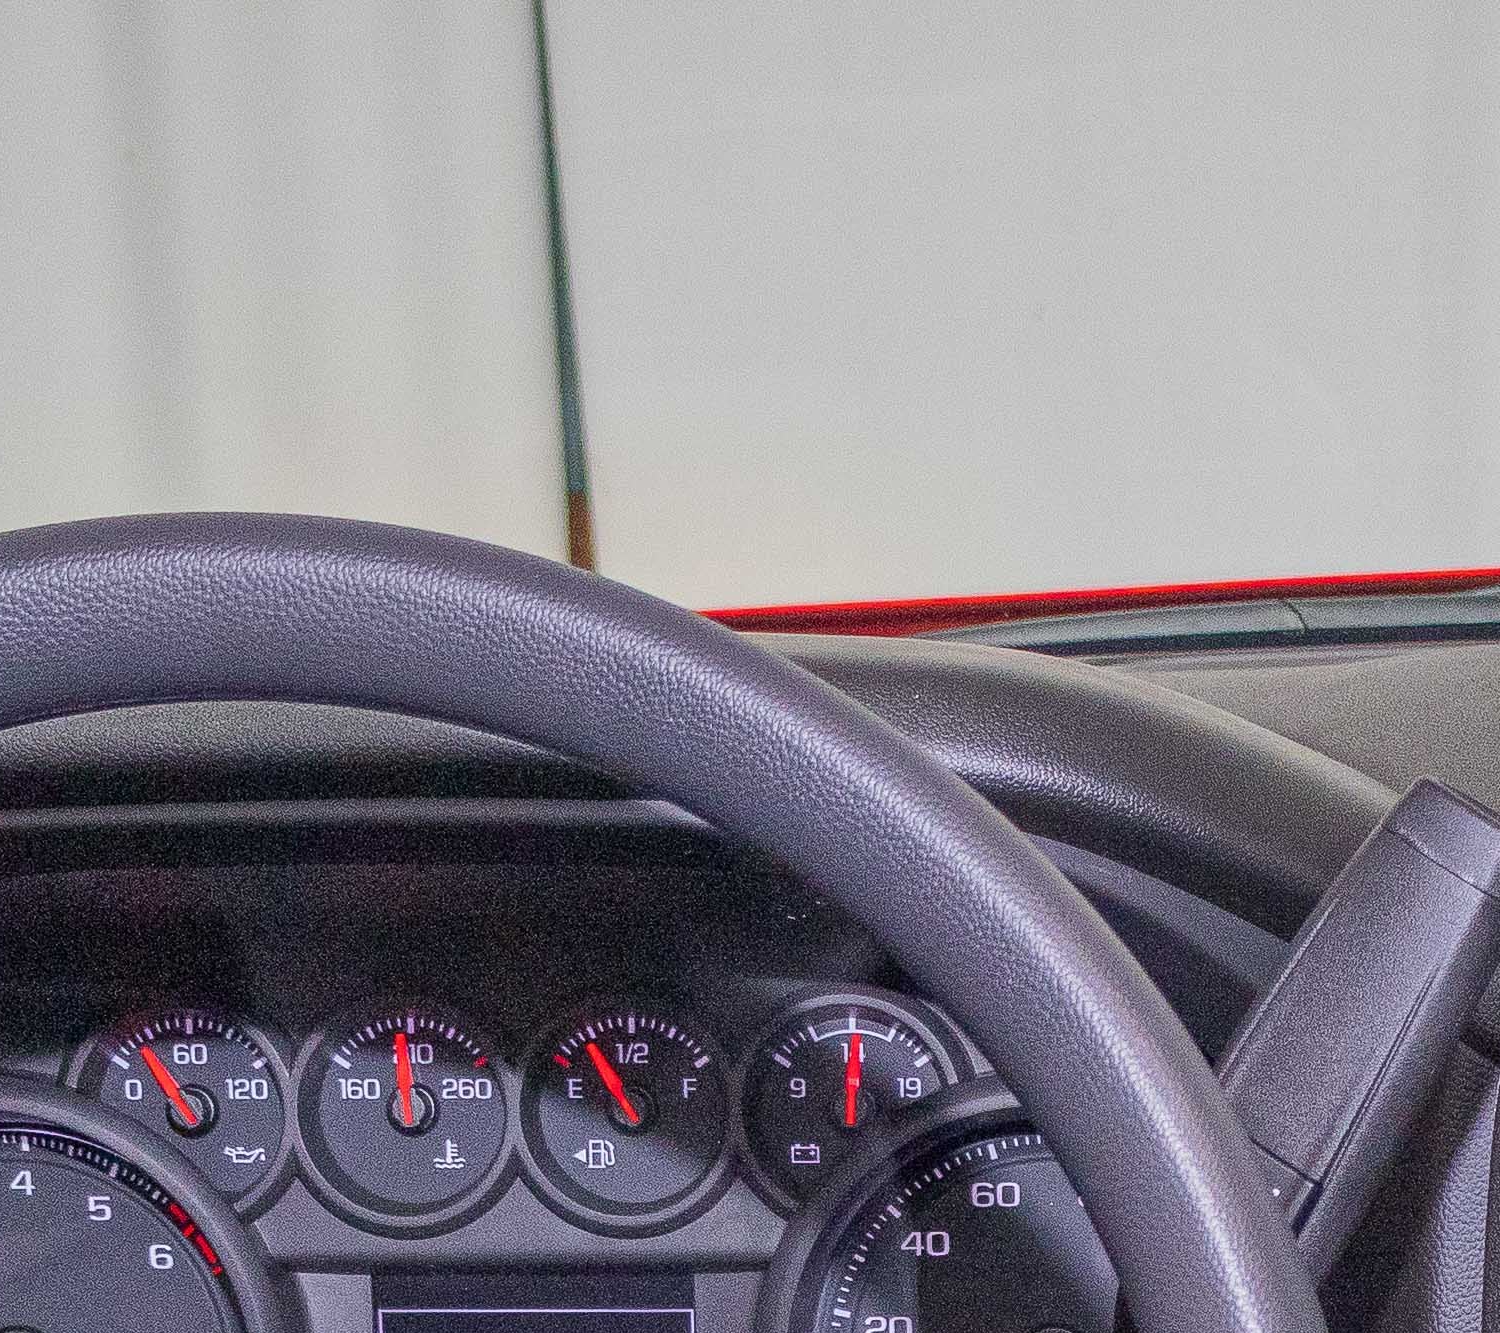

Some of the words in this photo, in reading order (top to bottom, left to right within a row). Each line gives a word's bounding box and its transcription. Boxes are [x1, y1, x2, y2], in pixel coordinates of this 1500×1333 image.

[173, 1043, 207, 1065] 60
[393, 1043, 434, 1065] 10
[615, 1043, 649, 1065] 1/2
[124, 1078, 143, 1101] 0
[225, 1078, 269, 1101] 120
[339, 1078, 381, 1101] 160
[441, 1078, 493, 1101] 260
[569, 1078, 583, 1099] E
[682, 1078, 698, 1098] F
[789, 1077, 807, 1098] 9
[897, 1077, 922, 1098] 19
[10, 1170, 36, 1196] 4
[971, 1182, 1020, 1207] 60
[87, 1196, 113, 1221] 5
[900, 1231, 950, 1256] 40
[148, 1244, 174, 1271] 6
